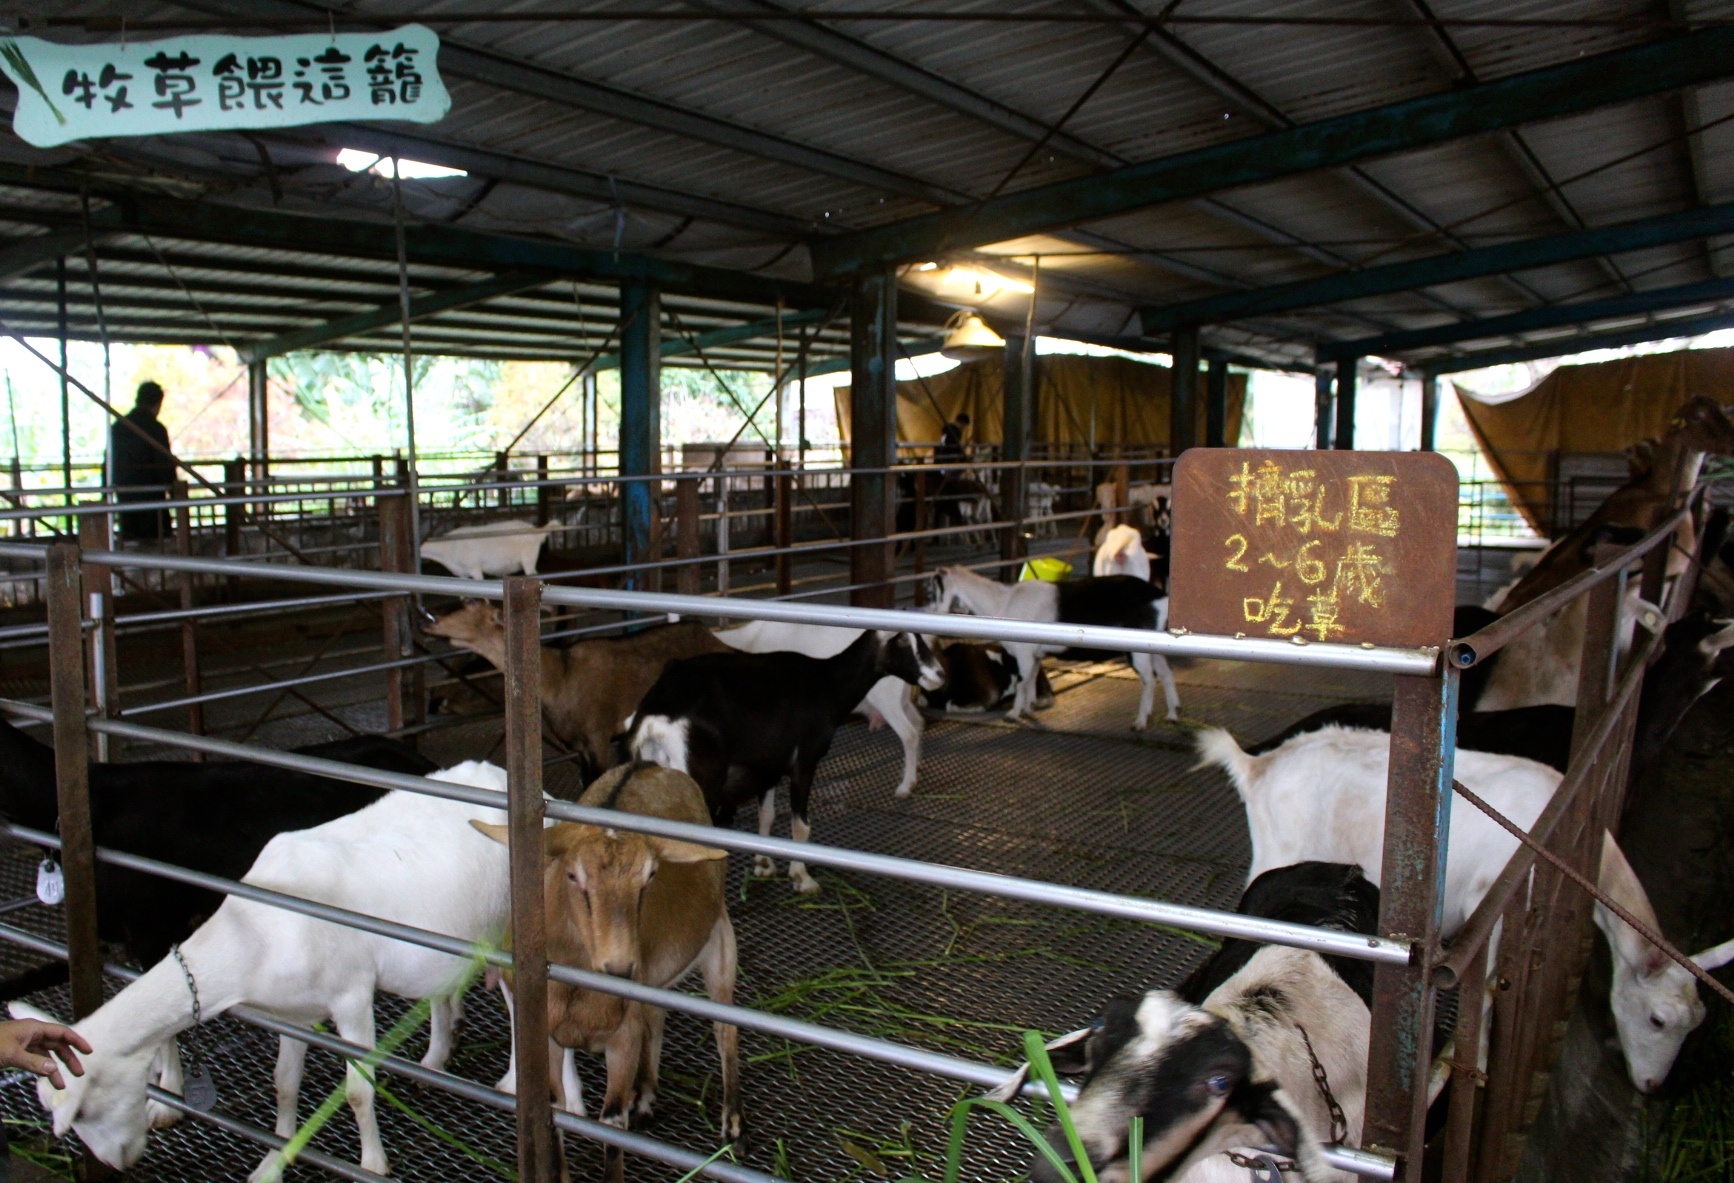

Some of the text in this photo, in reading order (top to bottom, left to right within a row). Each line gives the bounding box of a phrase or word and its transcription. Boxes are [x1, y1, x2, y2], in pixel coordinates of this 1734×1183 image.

[62, 42, 424, 120] 牧草餵這籠
[1243, 580, 1346, 642] 吃草
